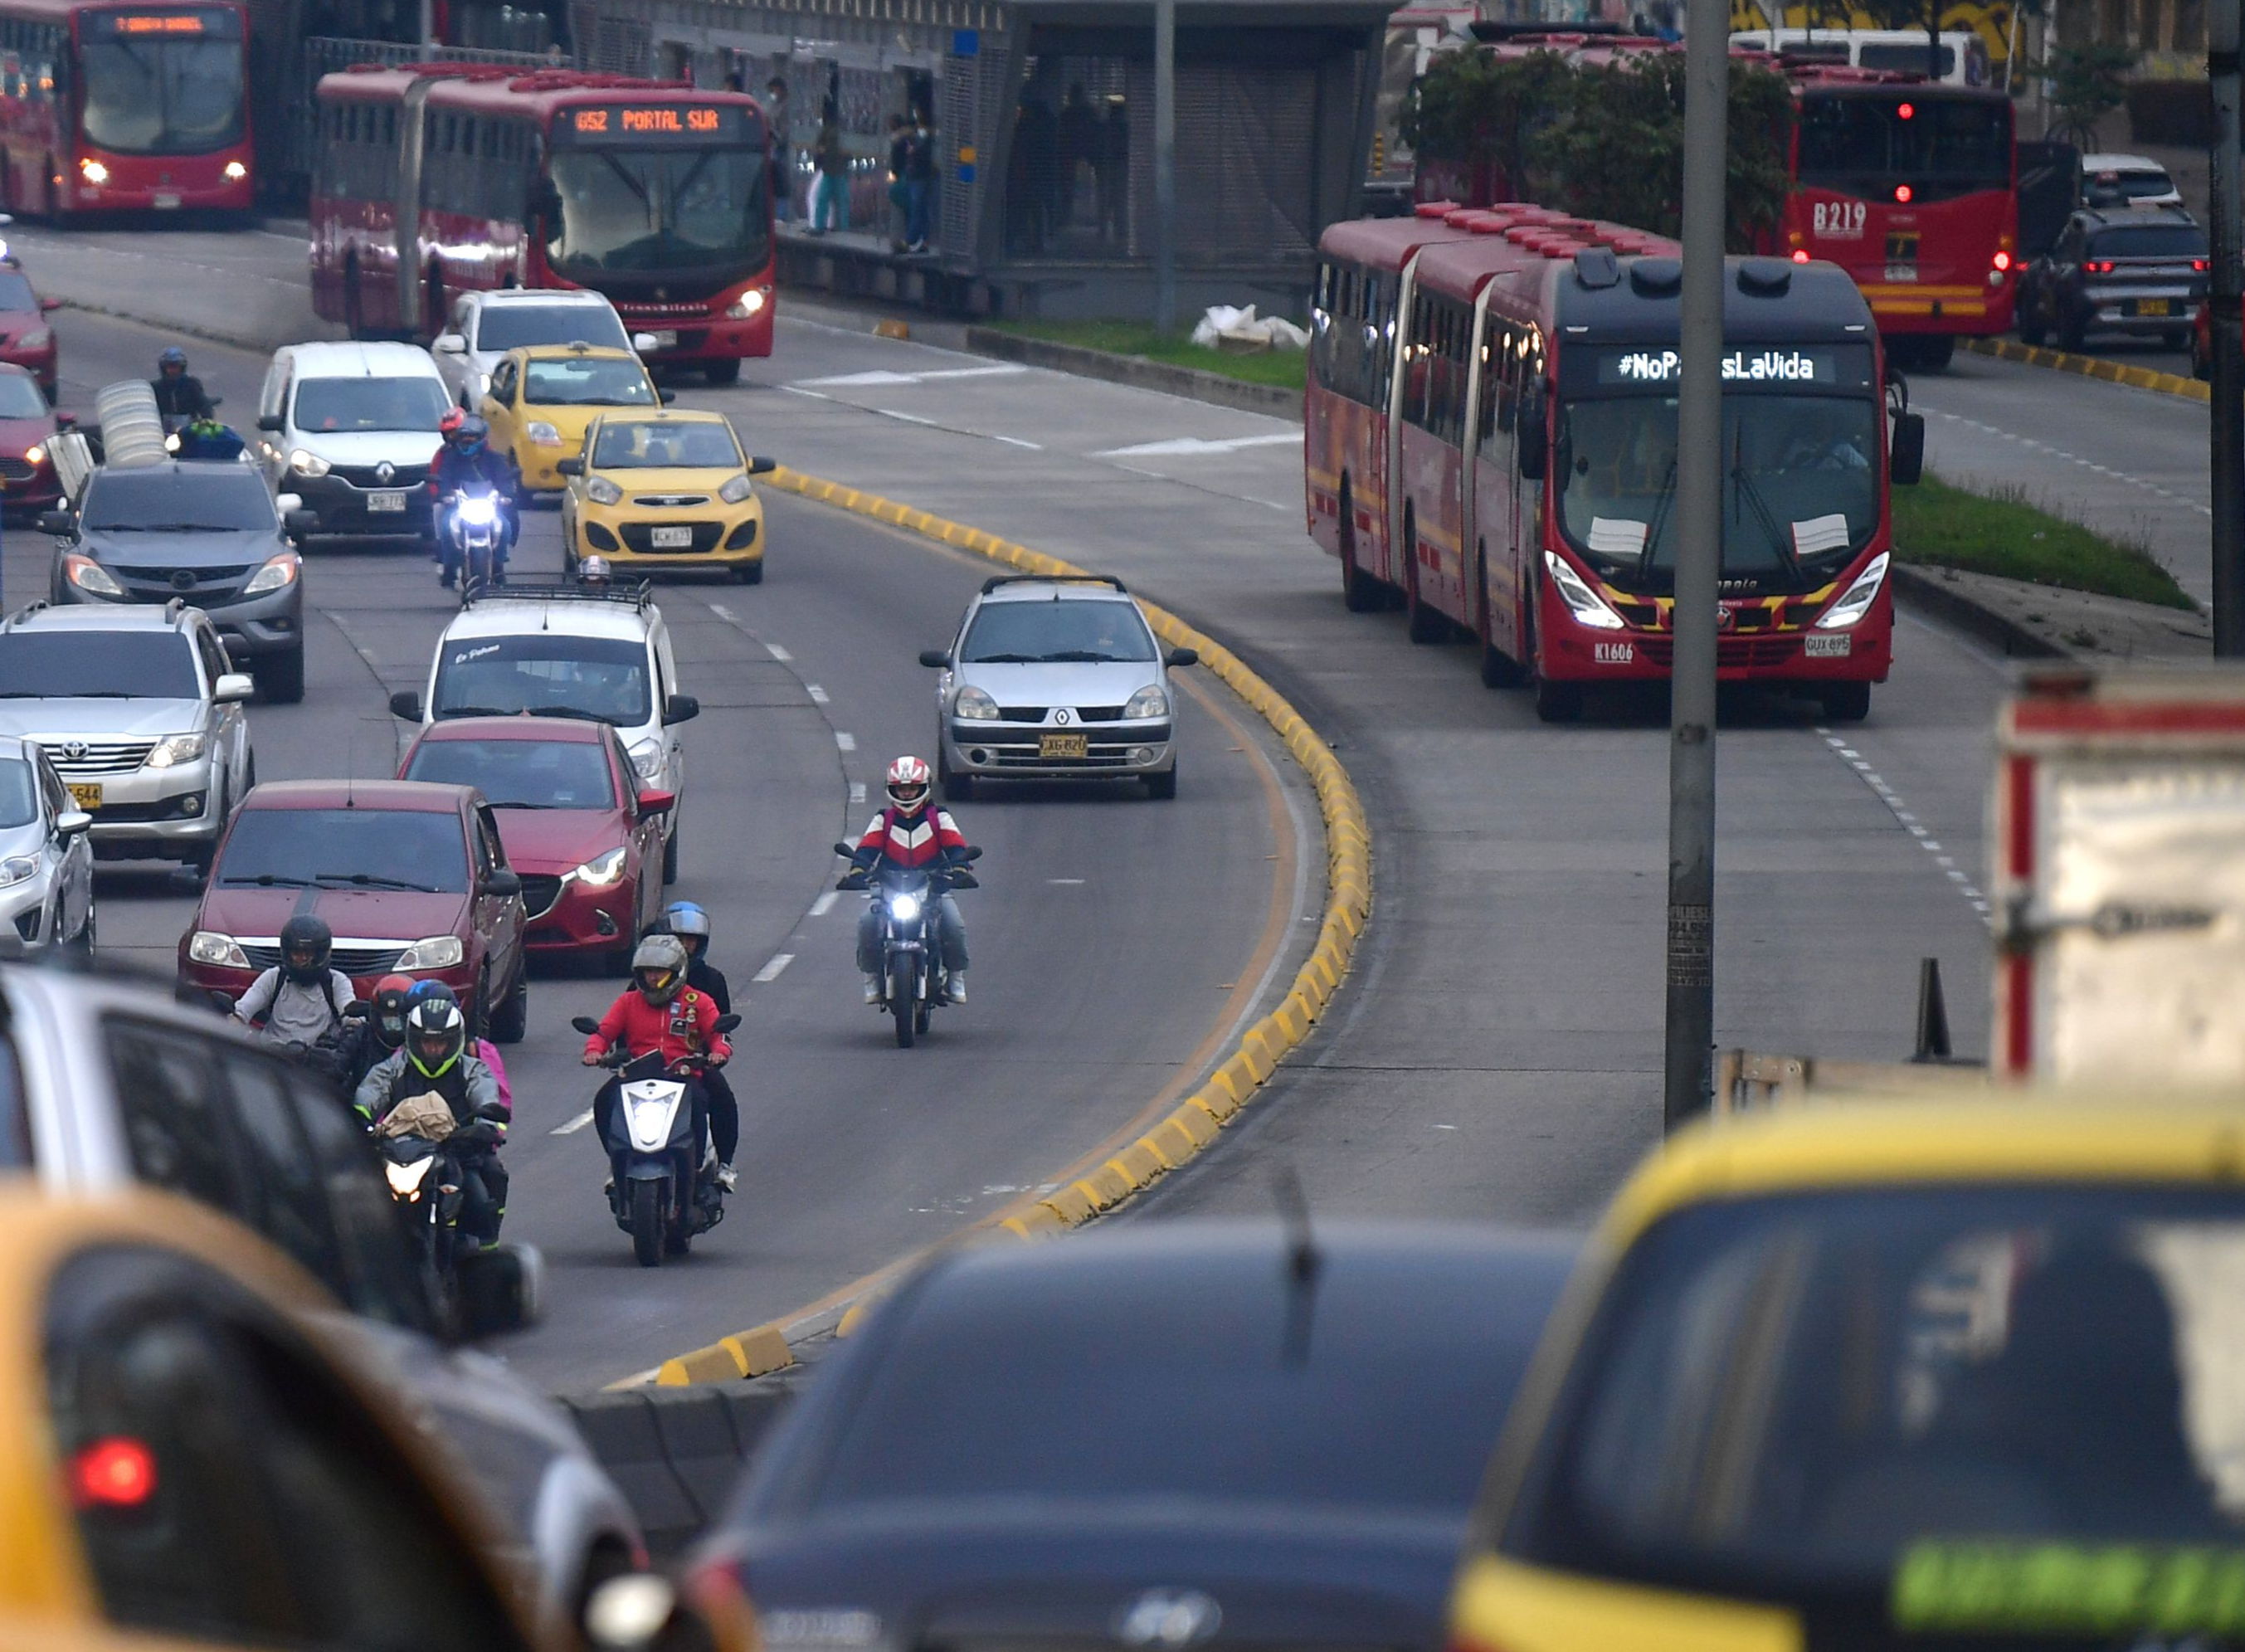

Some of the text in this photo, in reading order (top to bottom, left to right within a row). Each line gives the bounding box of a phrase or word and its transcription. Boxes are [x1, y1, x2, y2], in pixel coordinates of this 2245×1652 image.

[623, 110, 682, 130] PORTAL
[688, 110, 718, 129] SUR
[1814, 202, 1866, 231] B219
[1595, 642, 1633, 660] K1606
